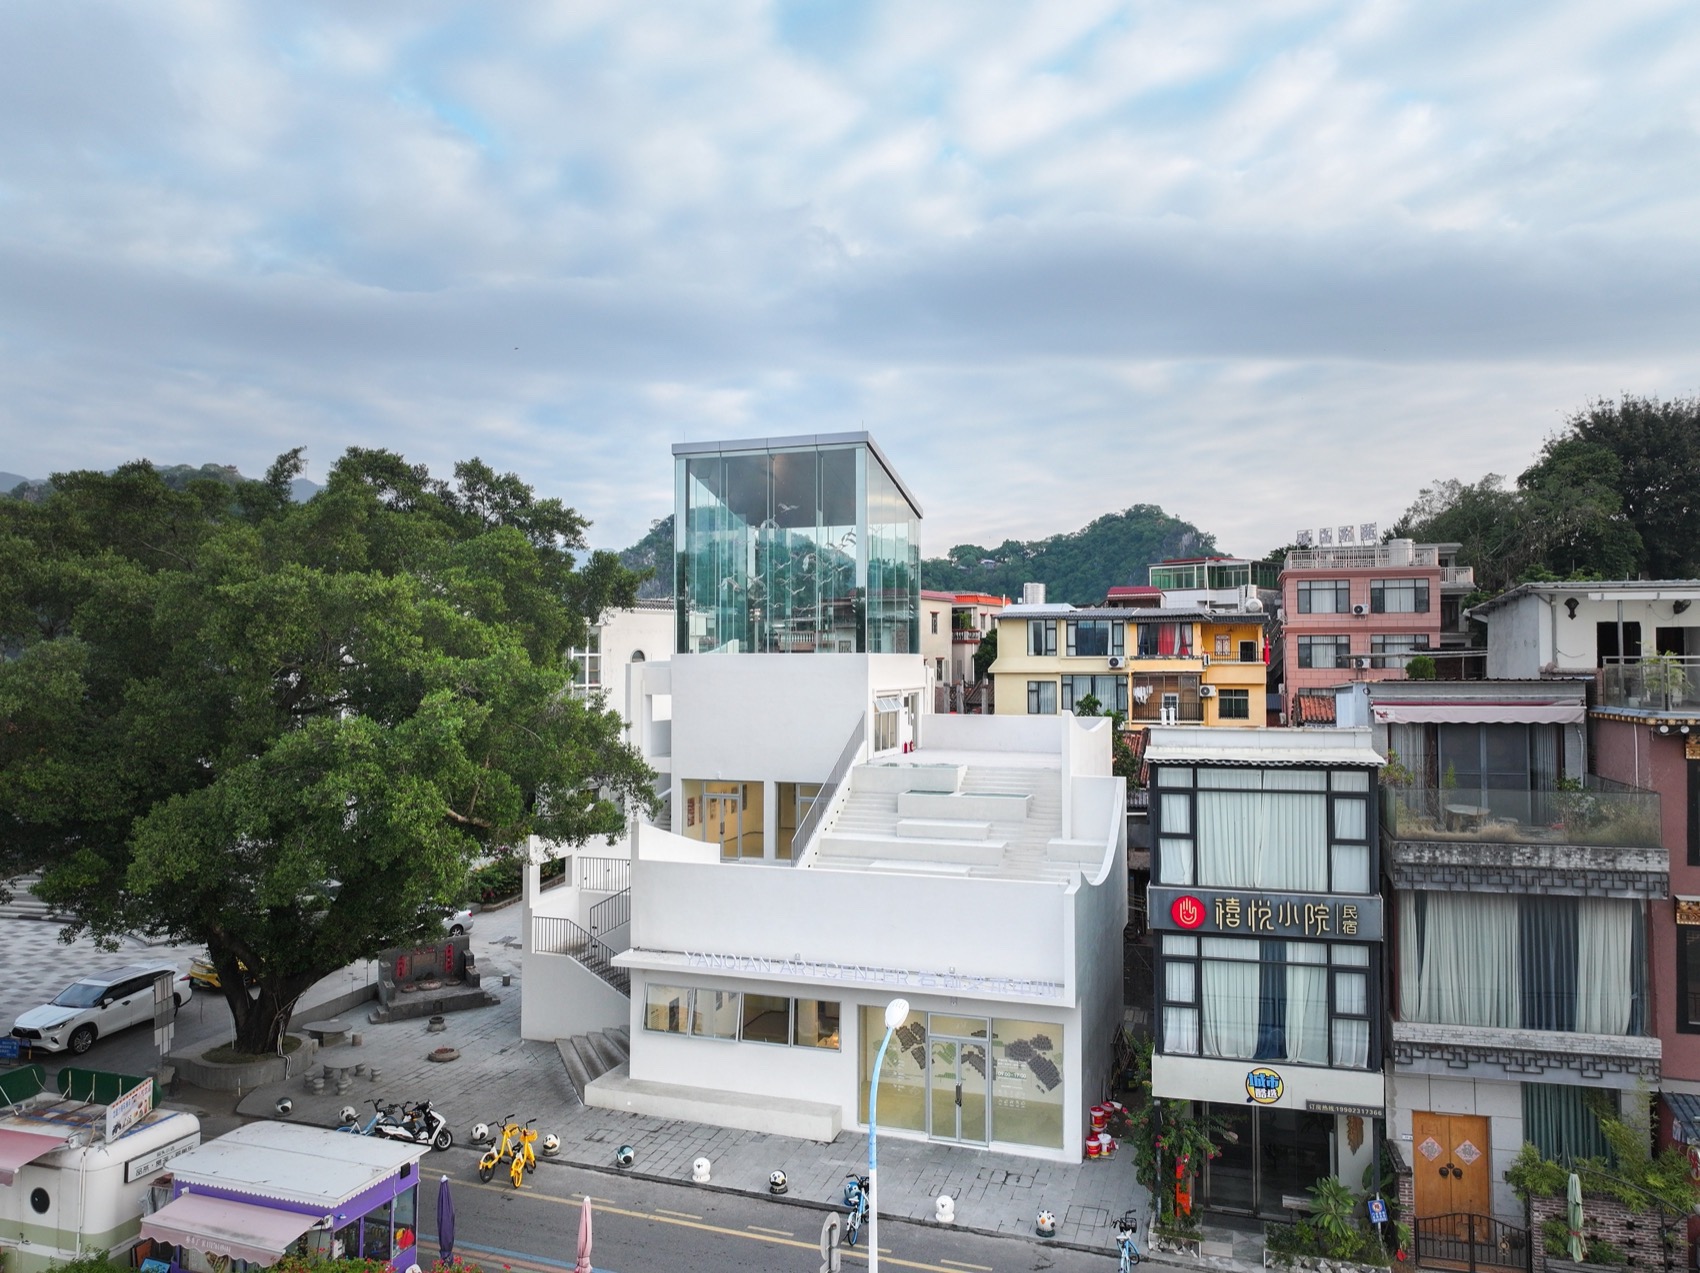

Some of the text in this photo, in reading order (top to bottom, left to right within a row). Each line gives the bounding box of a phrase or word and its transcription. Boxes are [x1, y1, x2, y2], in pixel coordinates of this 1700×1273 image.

[1215, 896, 1331, 936] 禧悦小院
[1342, 904, 1358, 935] 民宿
[684, 949, 909, 985] YANQIAN ART CENTER
[1247, 1071, 1280, 1089] 城市
